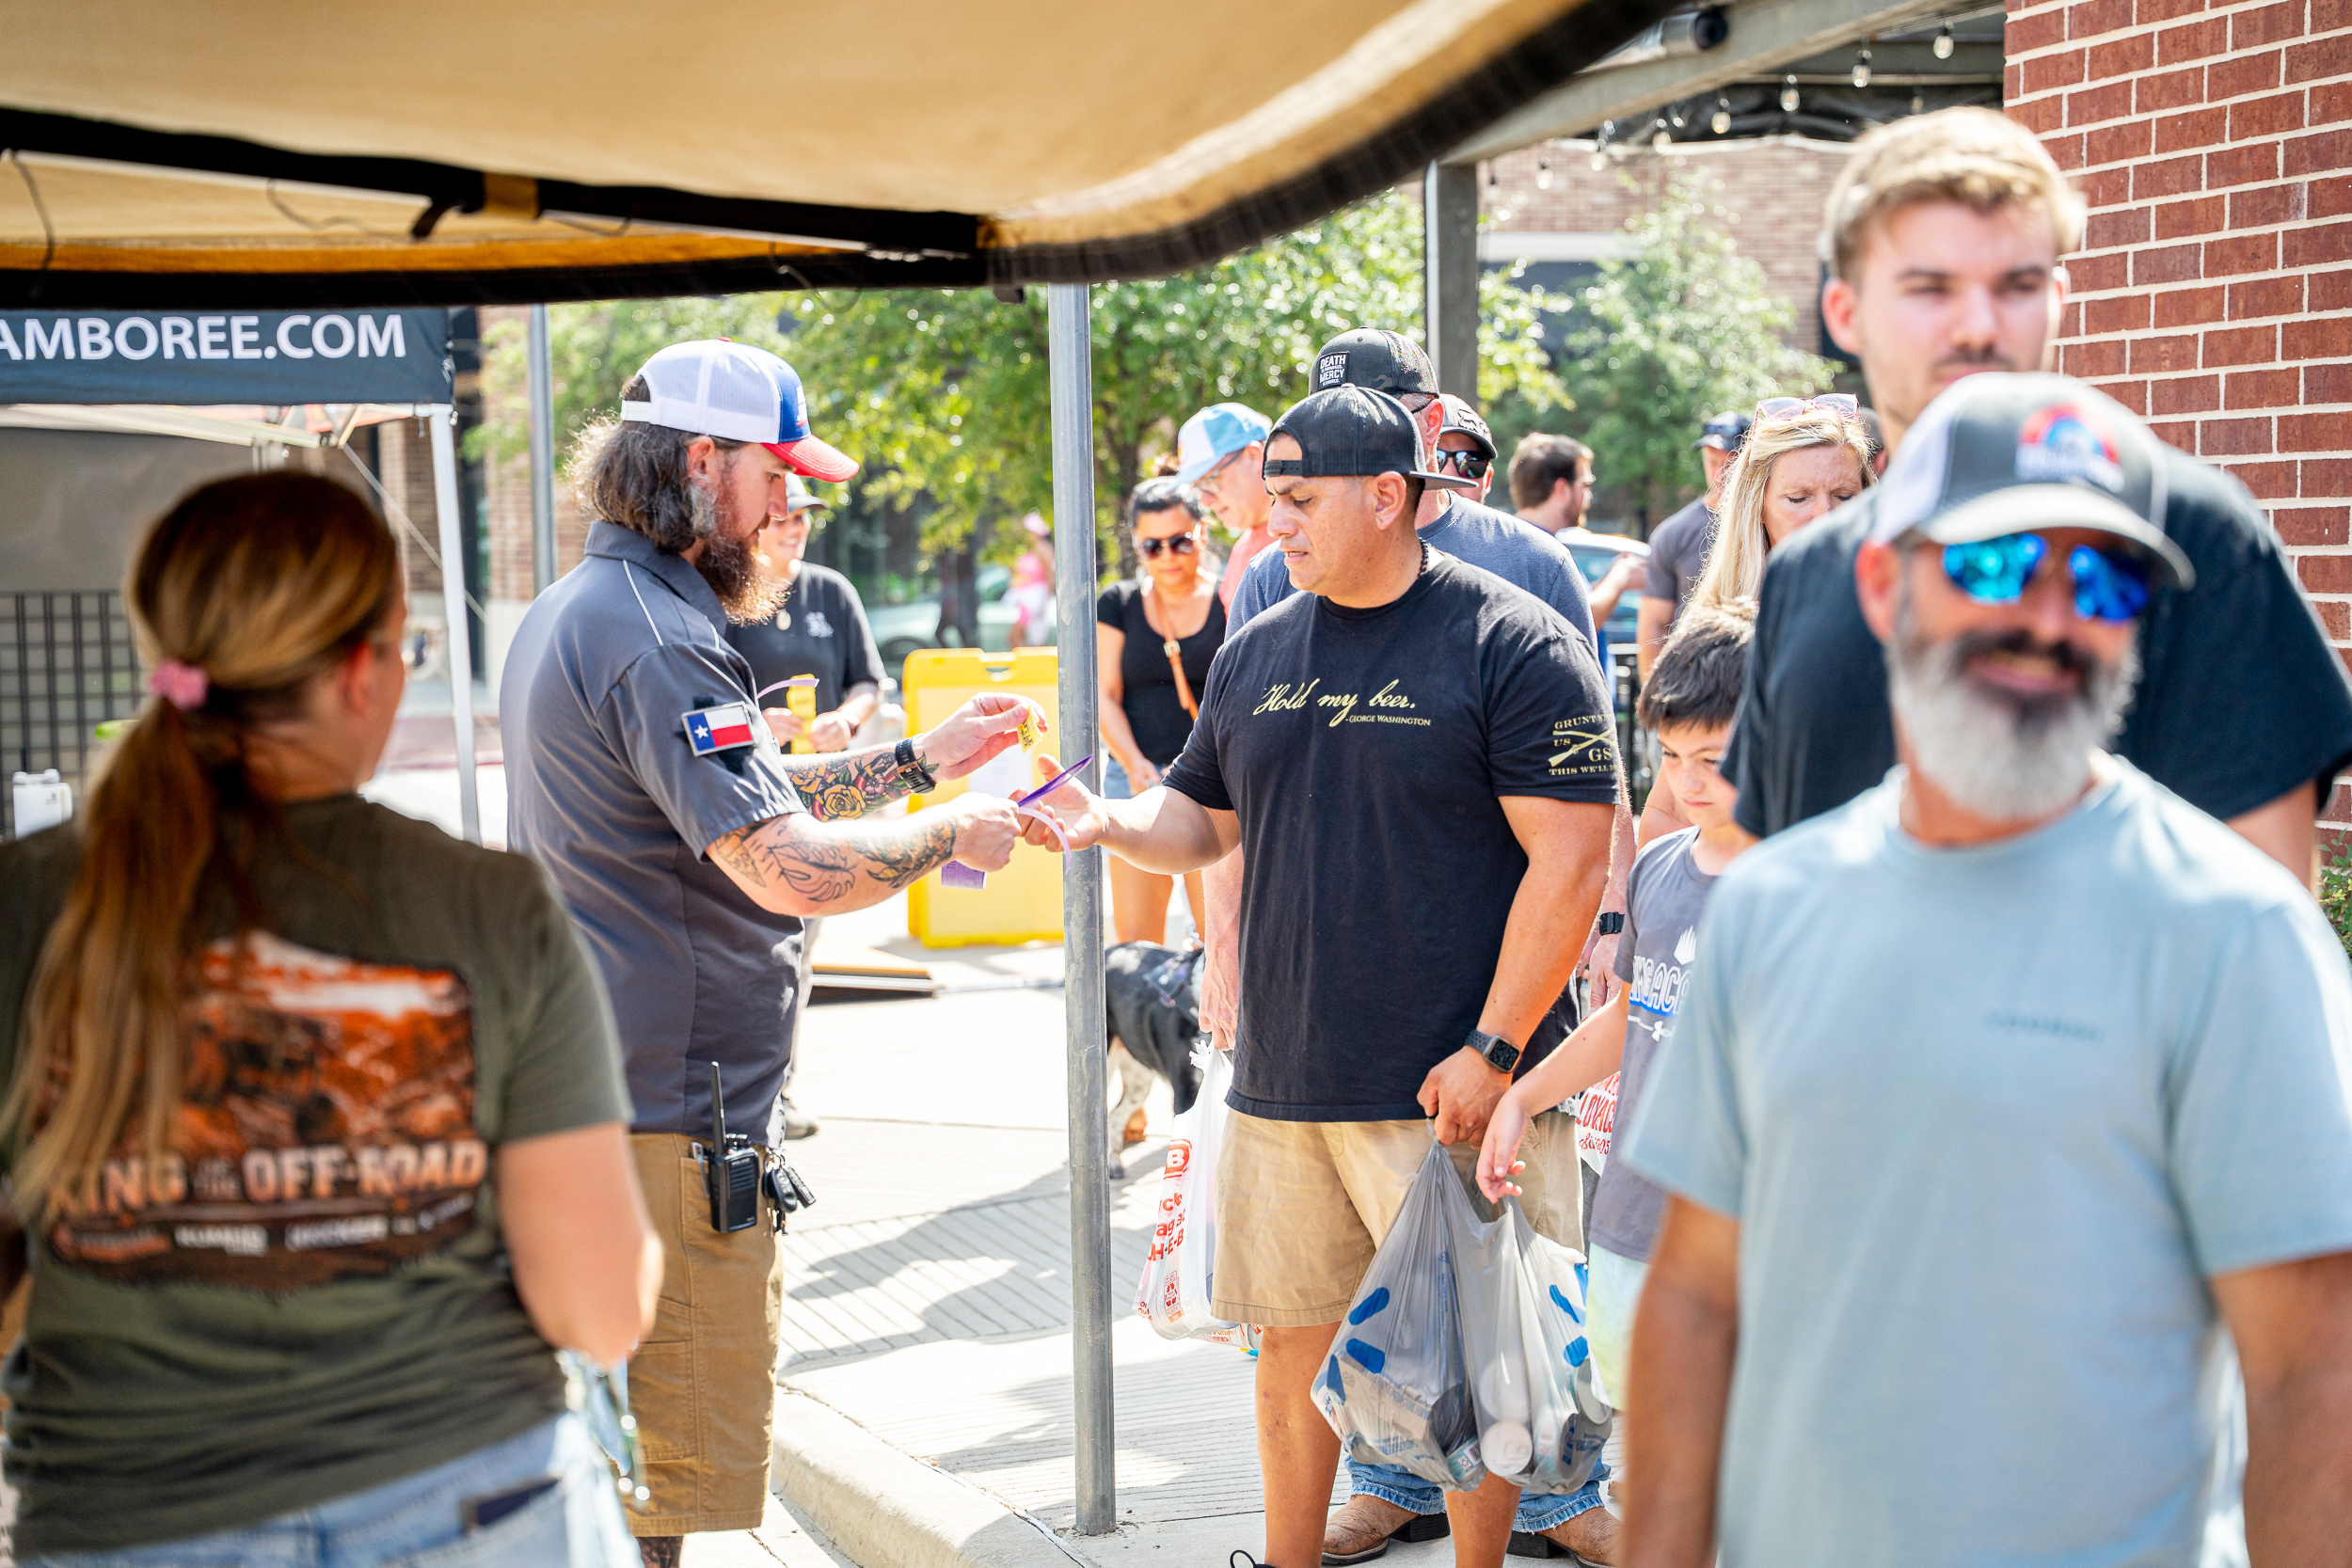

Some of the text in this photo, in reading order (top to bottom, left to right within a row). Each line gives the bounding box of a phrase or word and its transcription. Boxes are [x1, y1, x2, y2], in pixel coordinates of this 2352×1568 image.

[1320, 355, 1346, 370] DEATH
[1319, 369, 1345, 384] MERCY
[1252, 677, 1416, 728] Hold my beer.
[1377, 714, 1431, 727] WASHINGTON
[1554, 715, 1597, 730] GRUNT
[1553, 737, 1571, 747] US
[1588, 747, 1613, 762] GS
[1549, 768, 1578, 776] THIS
[1581, 764, 1608, 773] WE'LL
[242, 1139, 488, 1202] OFF-ROAD
